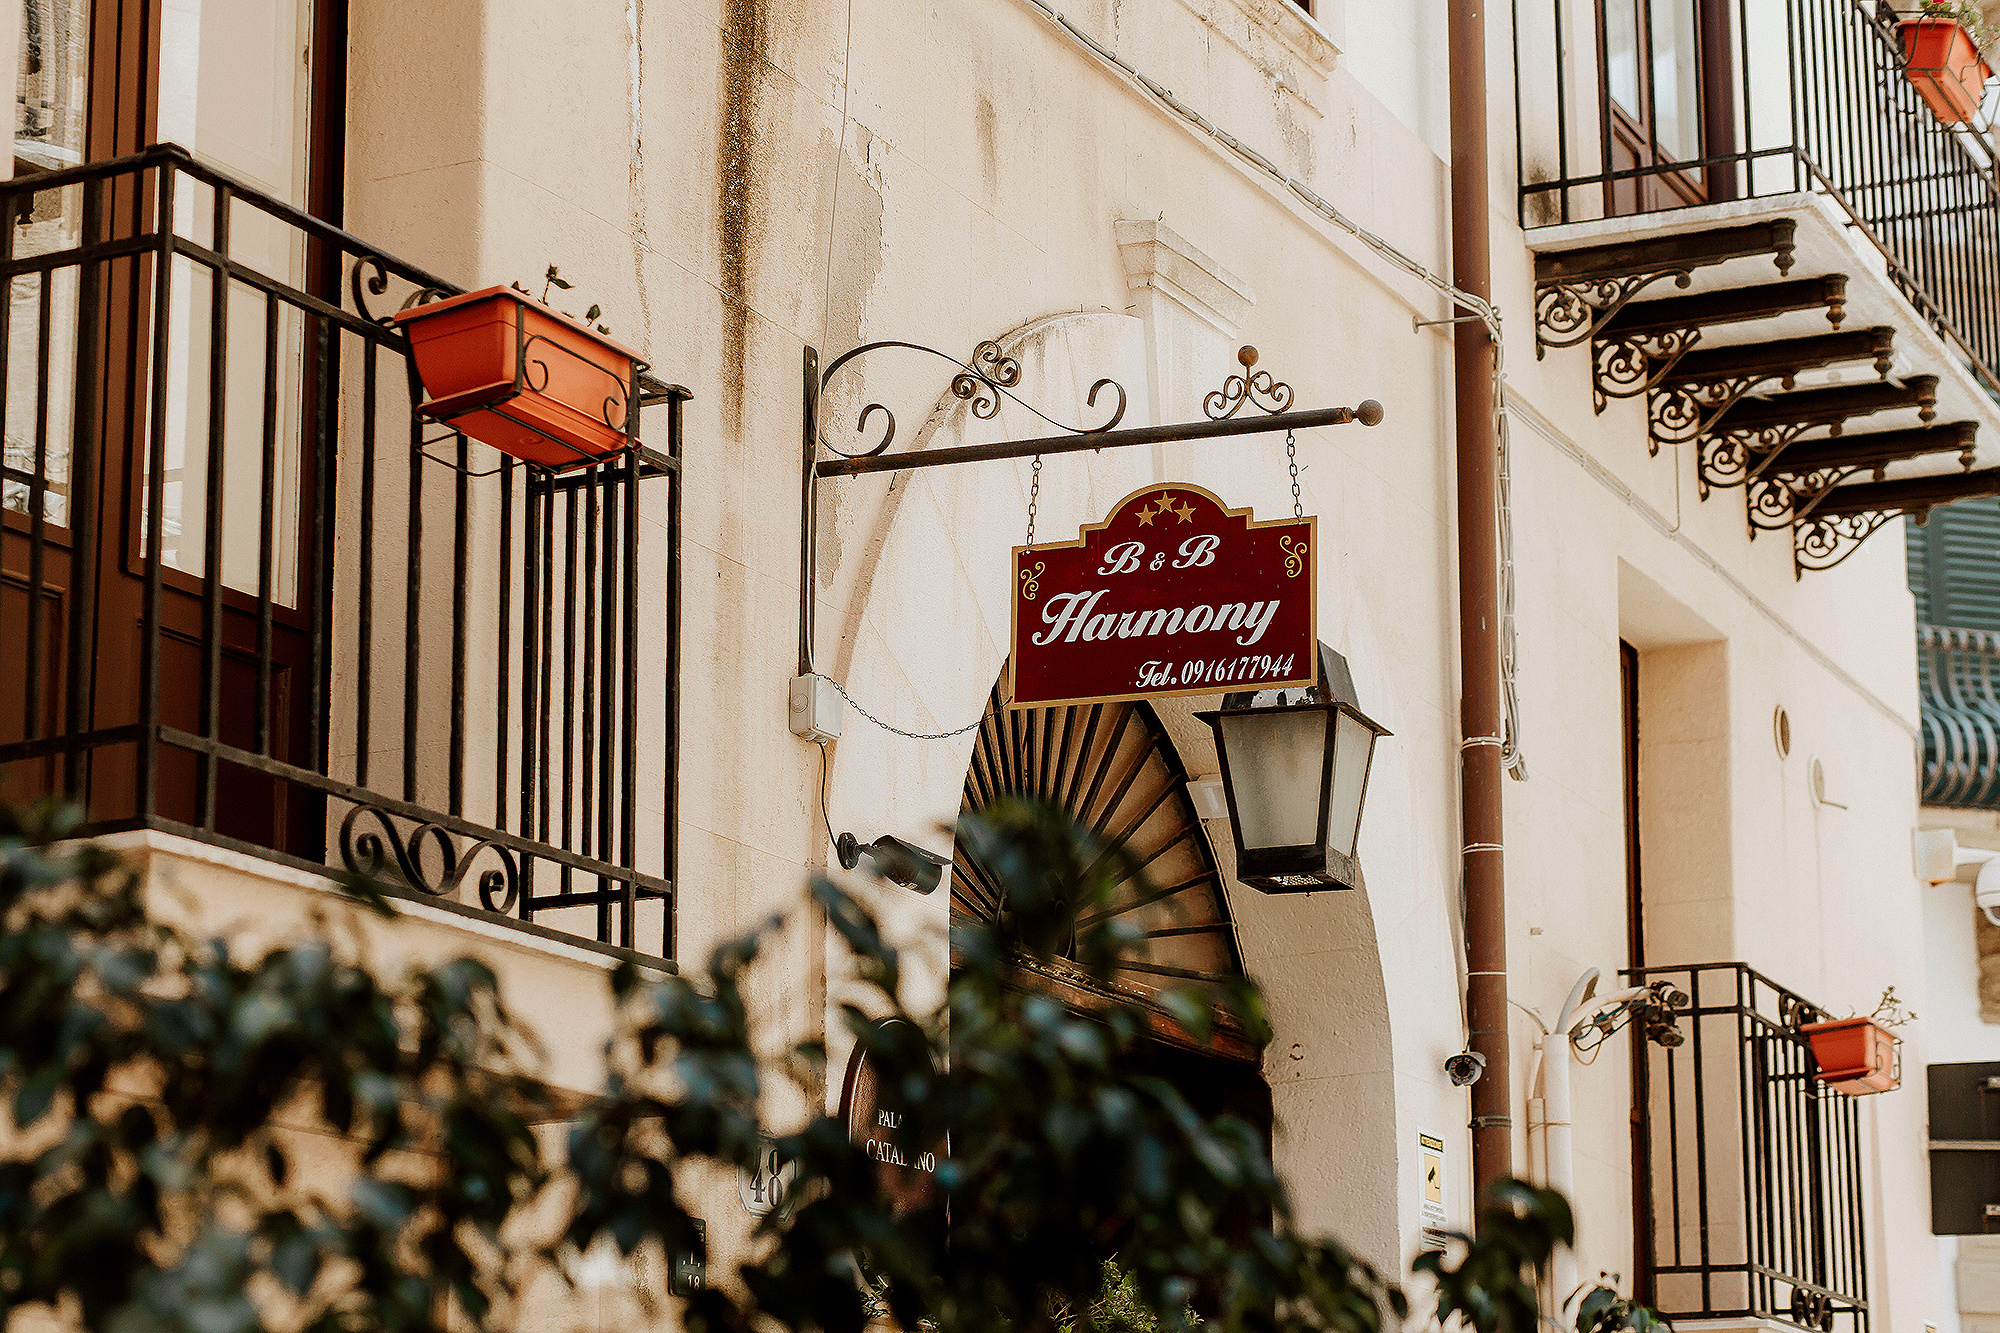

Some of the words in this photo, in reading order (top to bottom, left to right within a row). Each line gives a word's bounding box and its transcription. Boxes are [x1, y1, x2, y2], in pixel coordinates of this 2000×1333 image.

[1097, 541, 1145, 576] B
[1149, 552, 1166, 571] &
[1171, 534, 1220, 569] B
[1031, 589, 1281, 646] Harmony
[750, 1147, 782, 1206] 48
[866, 1138, 935, 1172] CATALNO
